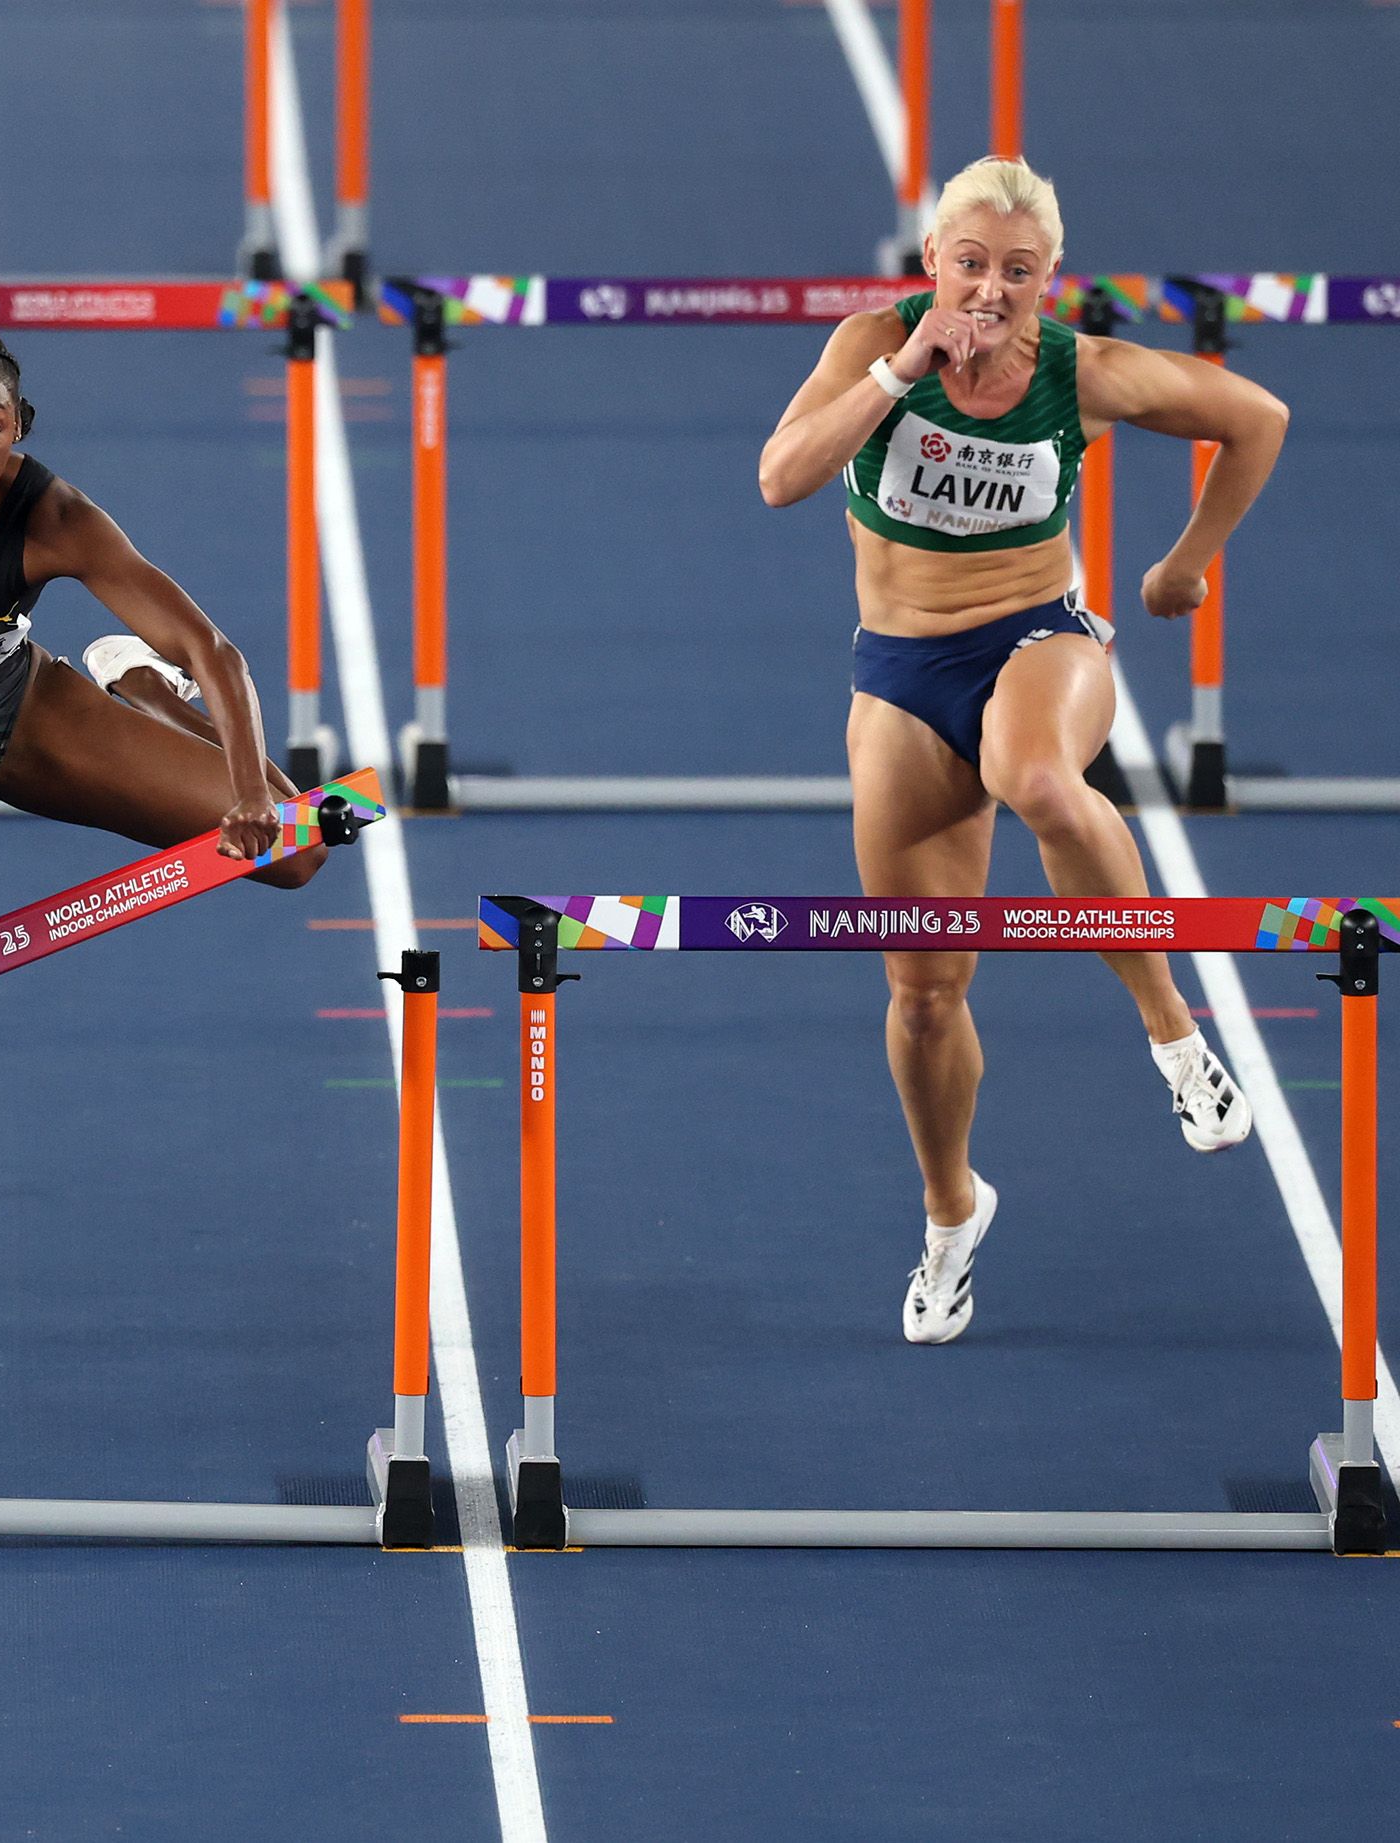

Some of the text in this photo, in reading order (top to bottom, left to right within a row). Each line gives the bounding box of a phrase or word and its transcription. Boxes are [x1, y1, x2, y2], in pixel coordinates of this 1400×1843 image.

[910, 465, 1025, 513] LAVIN
[45, 860, 186, 927] WORLD ATHLETICS
[48, 876, 189, 942] INDOOR CHAMPIONSHIPS
[809, 906, 981, 940] NANJING 25
[1003, 909, 1175, 925] WORLD ATHLETICS
[1003, 927, 1175, 939] INDOOR CHAMPIONSHIPS
[0, 925, 31, 956] 25
[529, 1026, 547, 1101] MONDO
